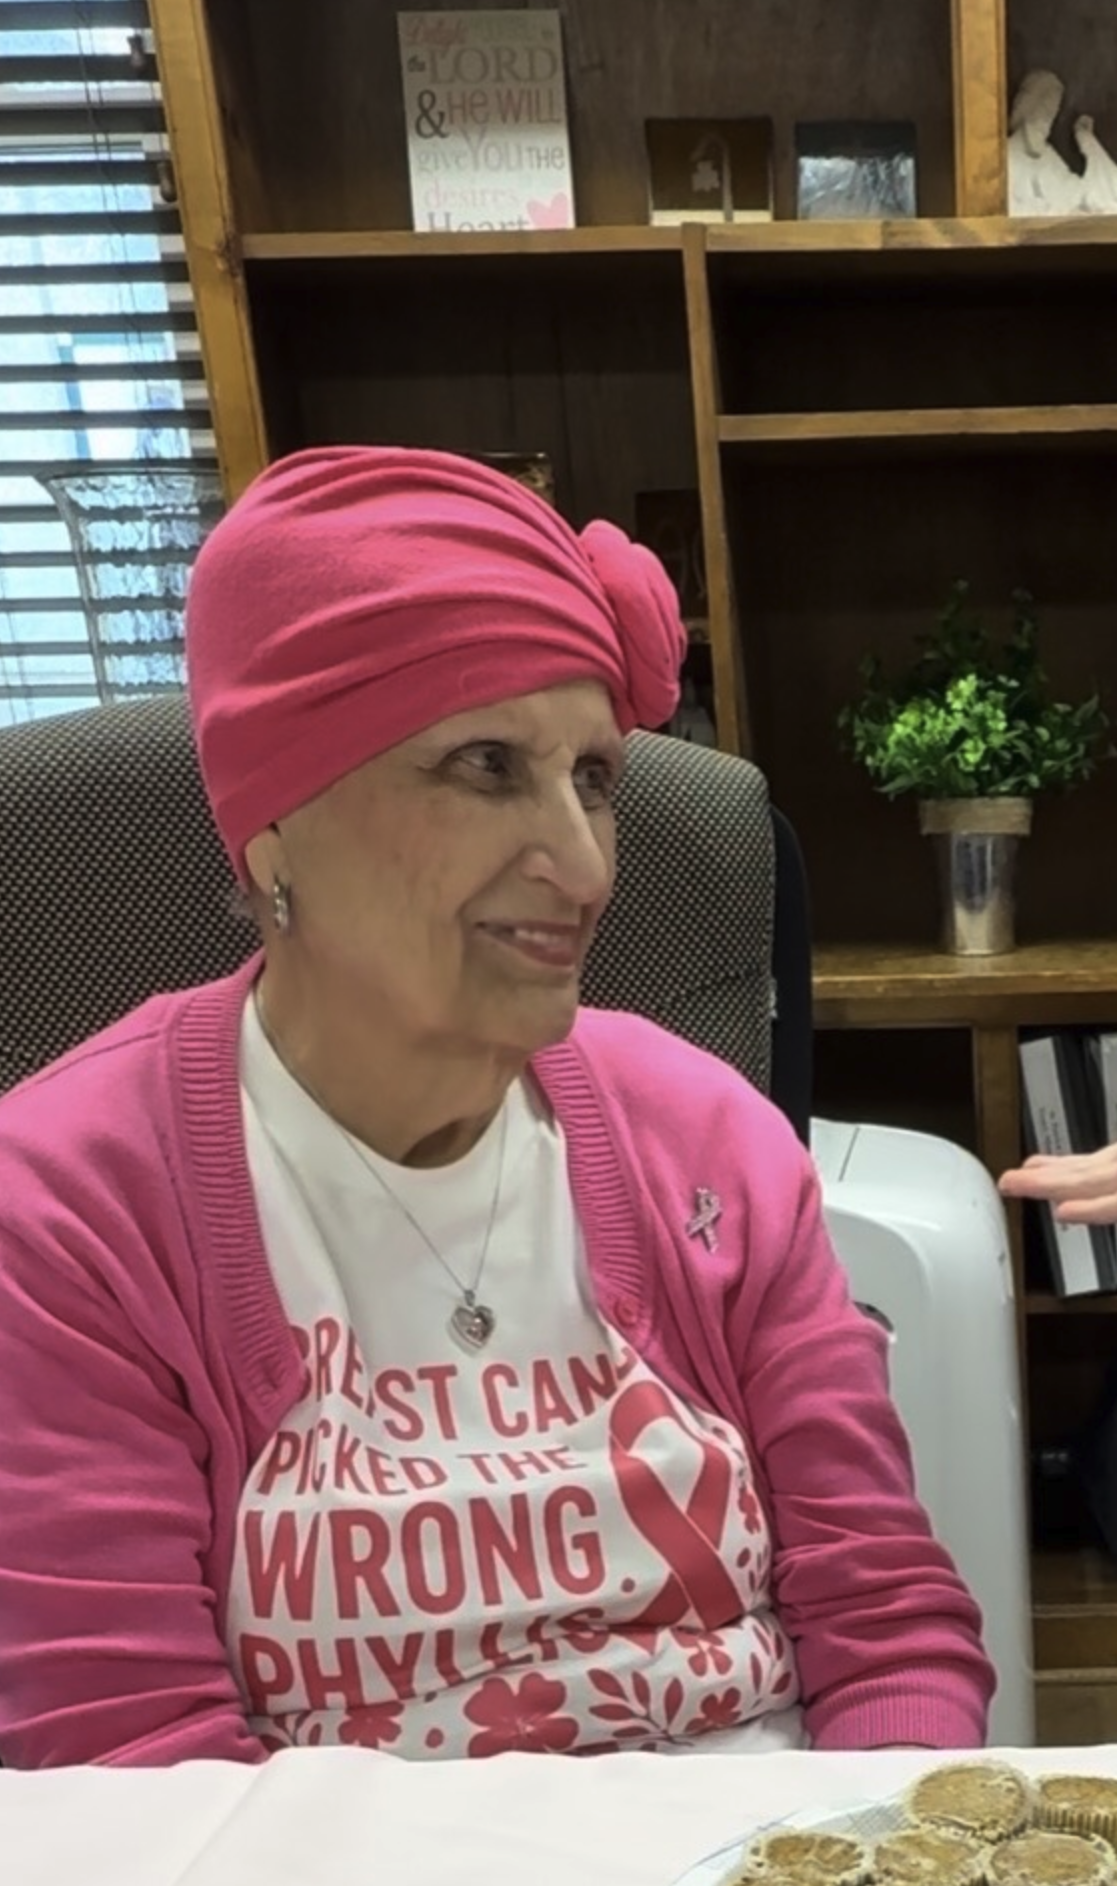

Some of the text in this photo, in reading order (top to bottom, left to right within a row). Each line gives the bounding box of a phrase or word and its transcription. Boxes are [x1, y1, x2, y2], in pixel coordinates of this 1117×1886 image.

[428, 47, 558, 84] LORD
[414, 89, 449, 138] &
[289, 1317, 458, 1442] REST
[257, 1418, 588, 1496] PICKED THE
[243, 1485, 606, 1621] WRONG
